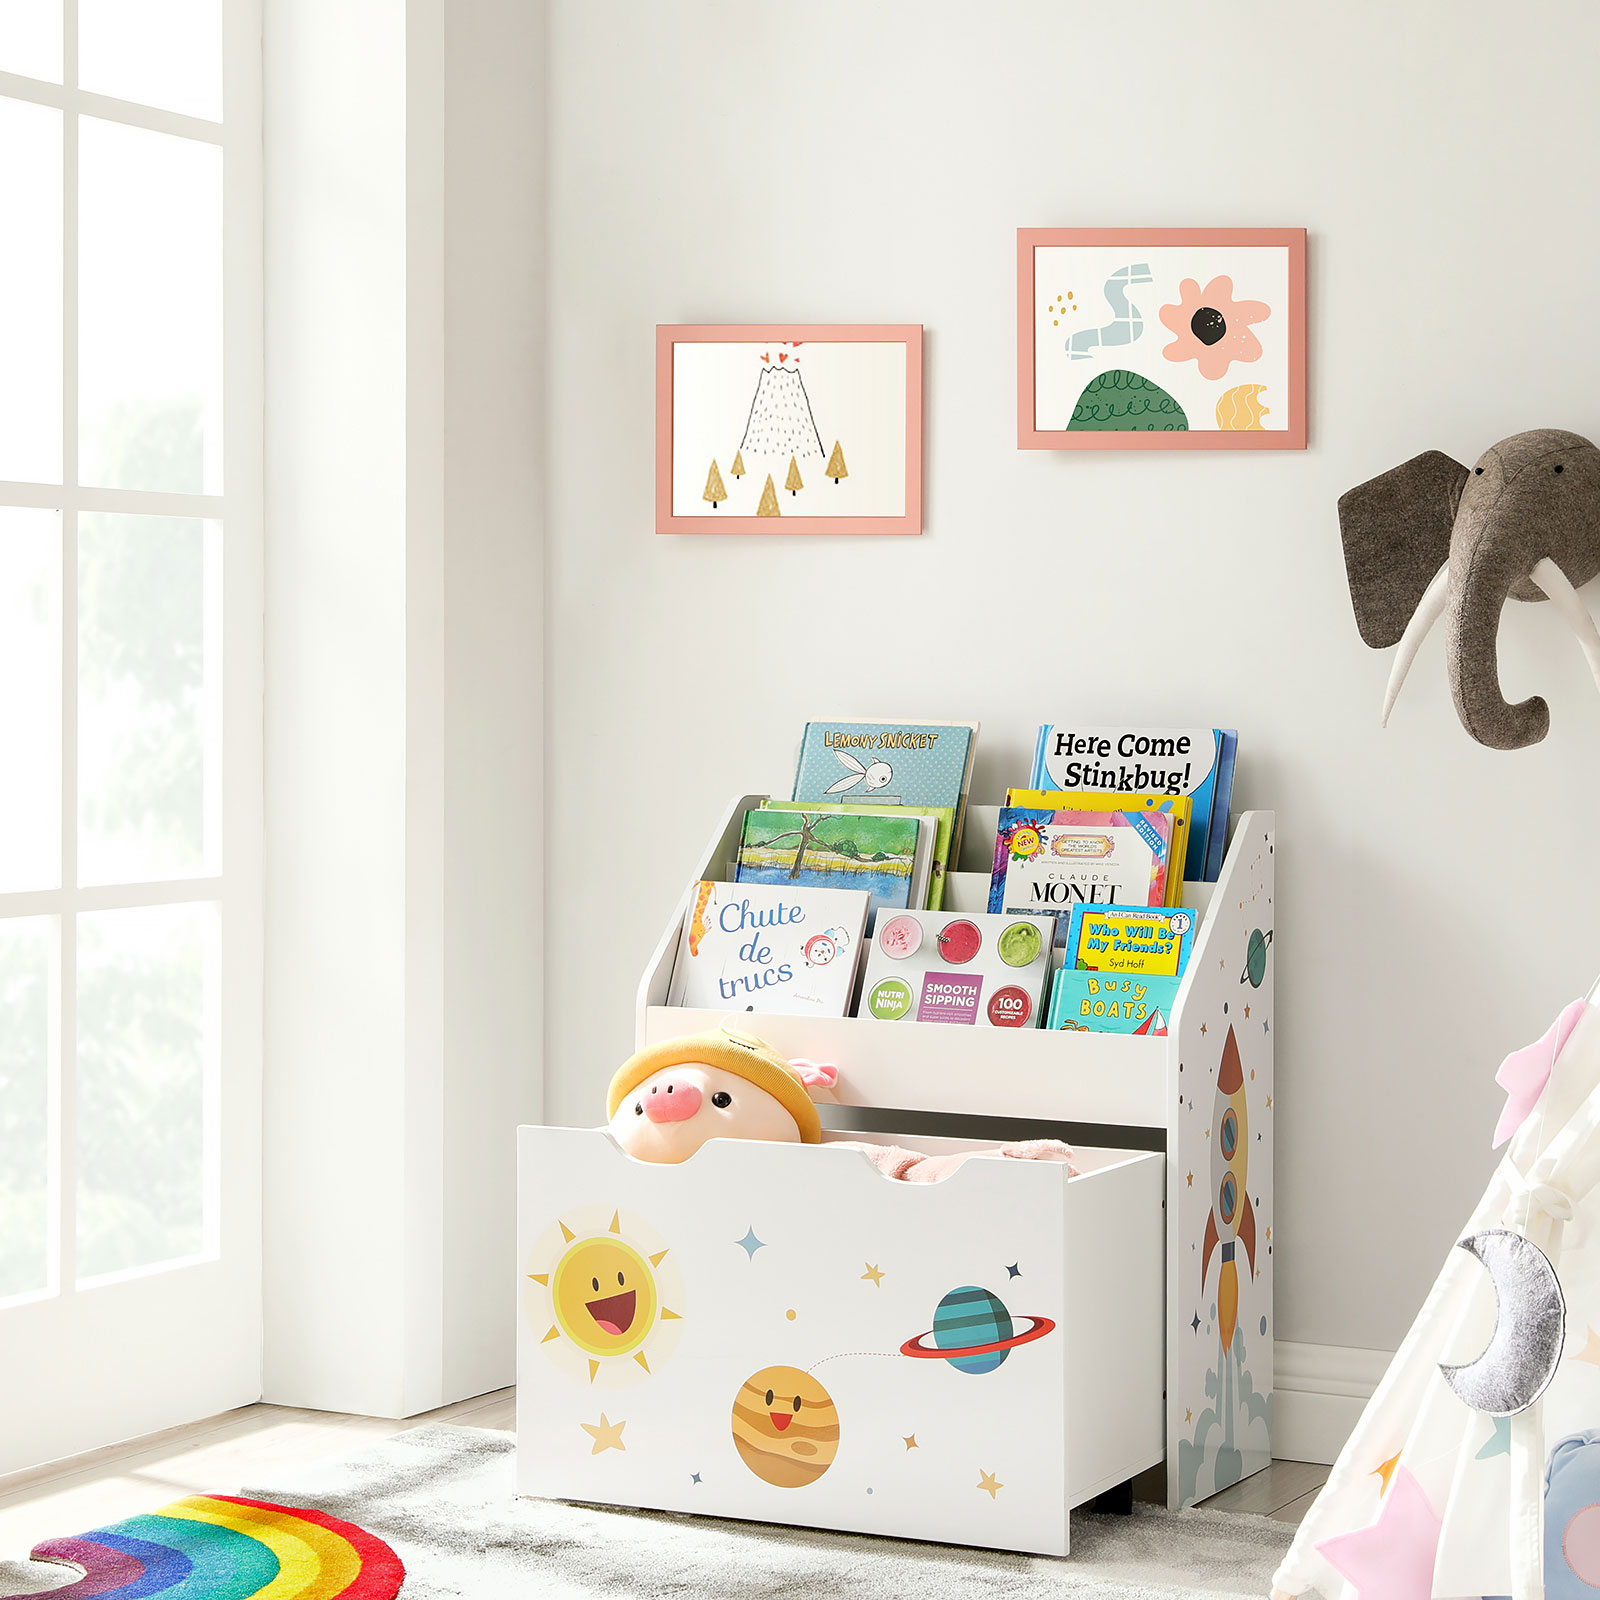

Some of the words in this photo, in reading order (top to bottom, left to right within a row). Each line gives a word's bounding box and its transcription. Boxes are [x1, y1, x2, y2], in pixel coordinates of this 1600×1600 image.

[824, 731, 877, 748] LEMONY
[877, 731, 938, 749] SNICKET
[1054, 733, 1111, 757] Here
[1117, 733, 1191, 757] Come
[1064, 761, 1191, 796] Stinkbug!
[1135, 823, 1159, 850] EDITION
[1139, 819, 1162, 846] REVISED
[1017, 837, 1035, 847] NEW
[1048, 873, 1109, 882] CLAUDE
[1030, 881, 1123, 904] MONET
[719, 898, 806, 933] Chute
[1176, 918, 1183, 930] 1
[1088, 923, 1119, 936] Who
[1125, 925, 1154, 938] Will
[1158, 927, 1175, 940] Be
[738, 931, 773, 965] de
[1087, 938, 1109, 953] My
[1113, 939, 1173, 954] Friends?
[1109, 958, 1125, 969] Syd
[1126, 959, 1145, 969] Hoff
[719, 963, 793, 999] trucs
[926, 983, 978, 996] SMOOTH
[1087, 978, 1148, 1001] Busy
[877, 990, 905, 999] NUTRI
[924, 994, 976, 1007] SIPPING
[875, 998, 904, 1012] NINJA
[998, 997, 1023, 1010] 100
[1080, 999, 1147, 1020] BOATS
